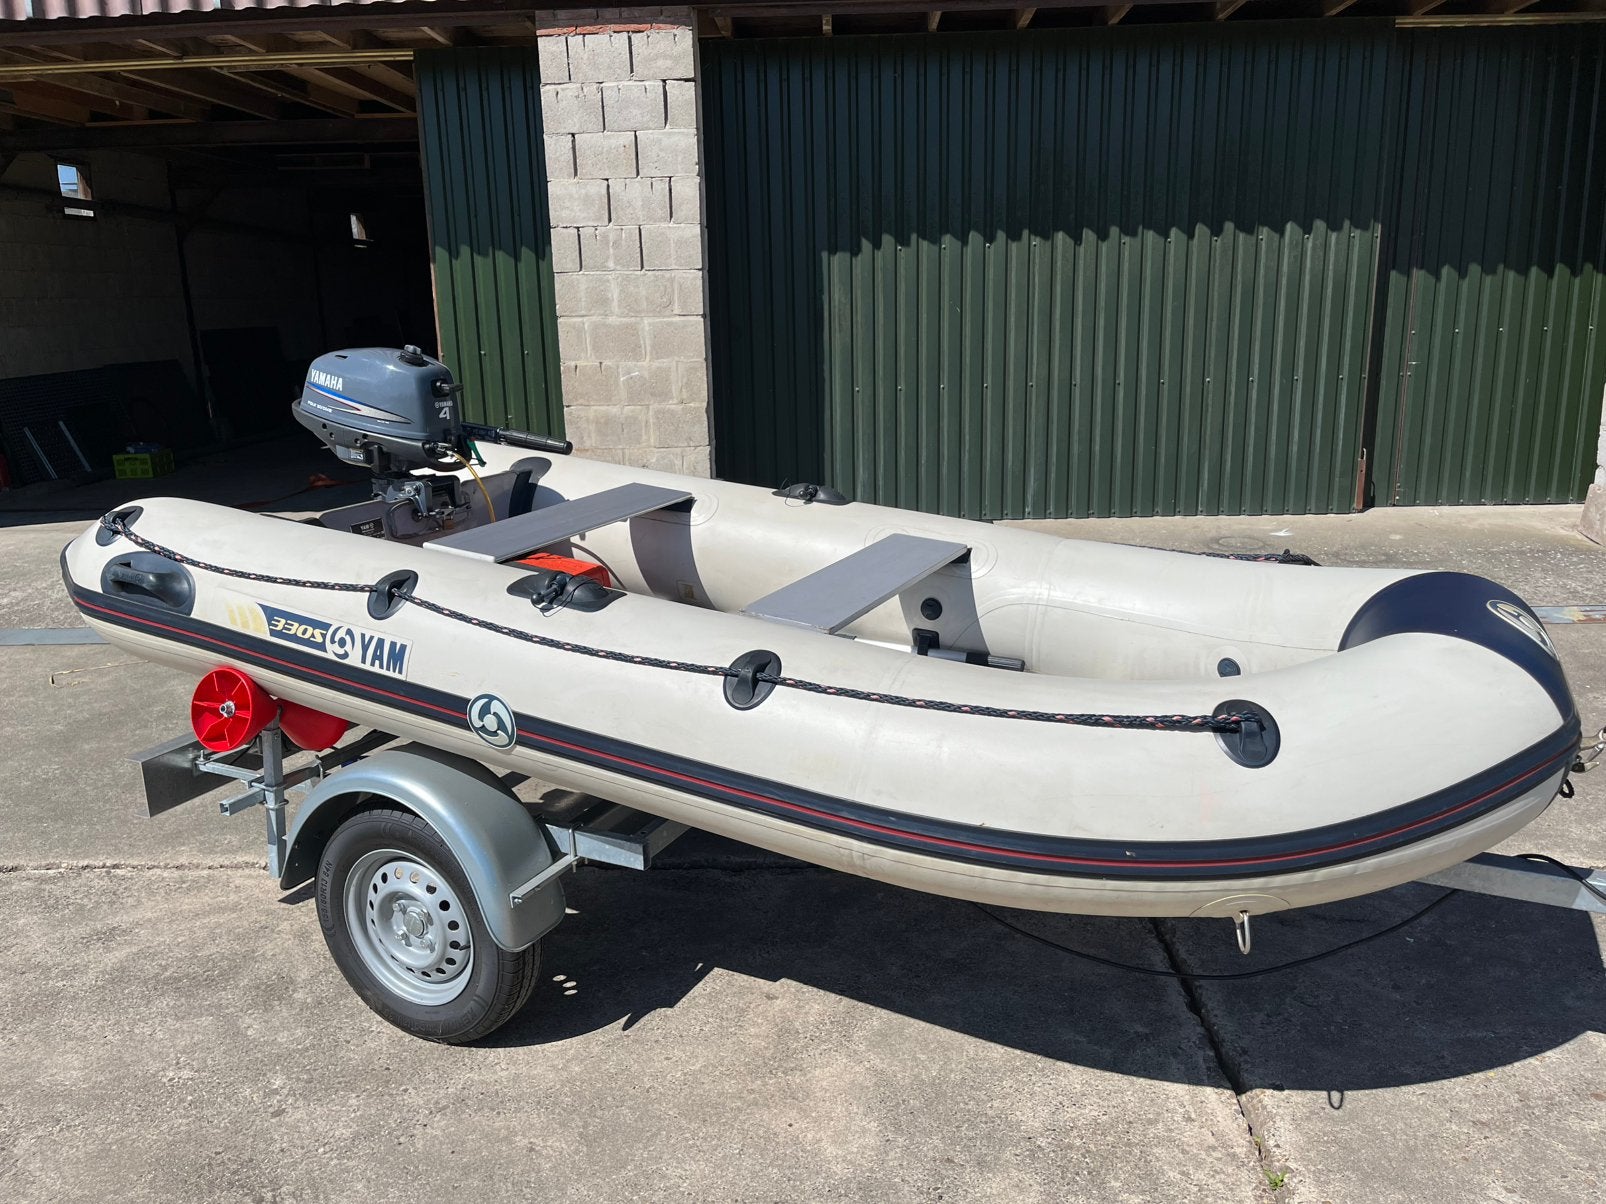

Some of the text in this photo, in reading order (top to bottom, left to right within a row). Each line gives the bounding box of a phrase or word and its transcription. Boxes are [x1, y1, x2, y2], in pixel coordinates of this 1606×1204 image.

[311, 368, 343, 391] YAMAHA
[438, 407, 451, 420] 4
[269, 616, 408, 675] 330S YAM
